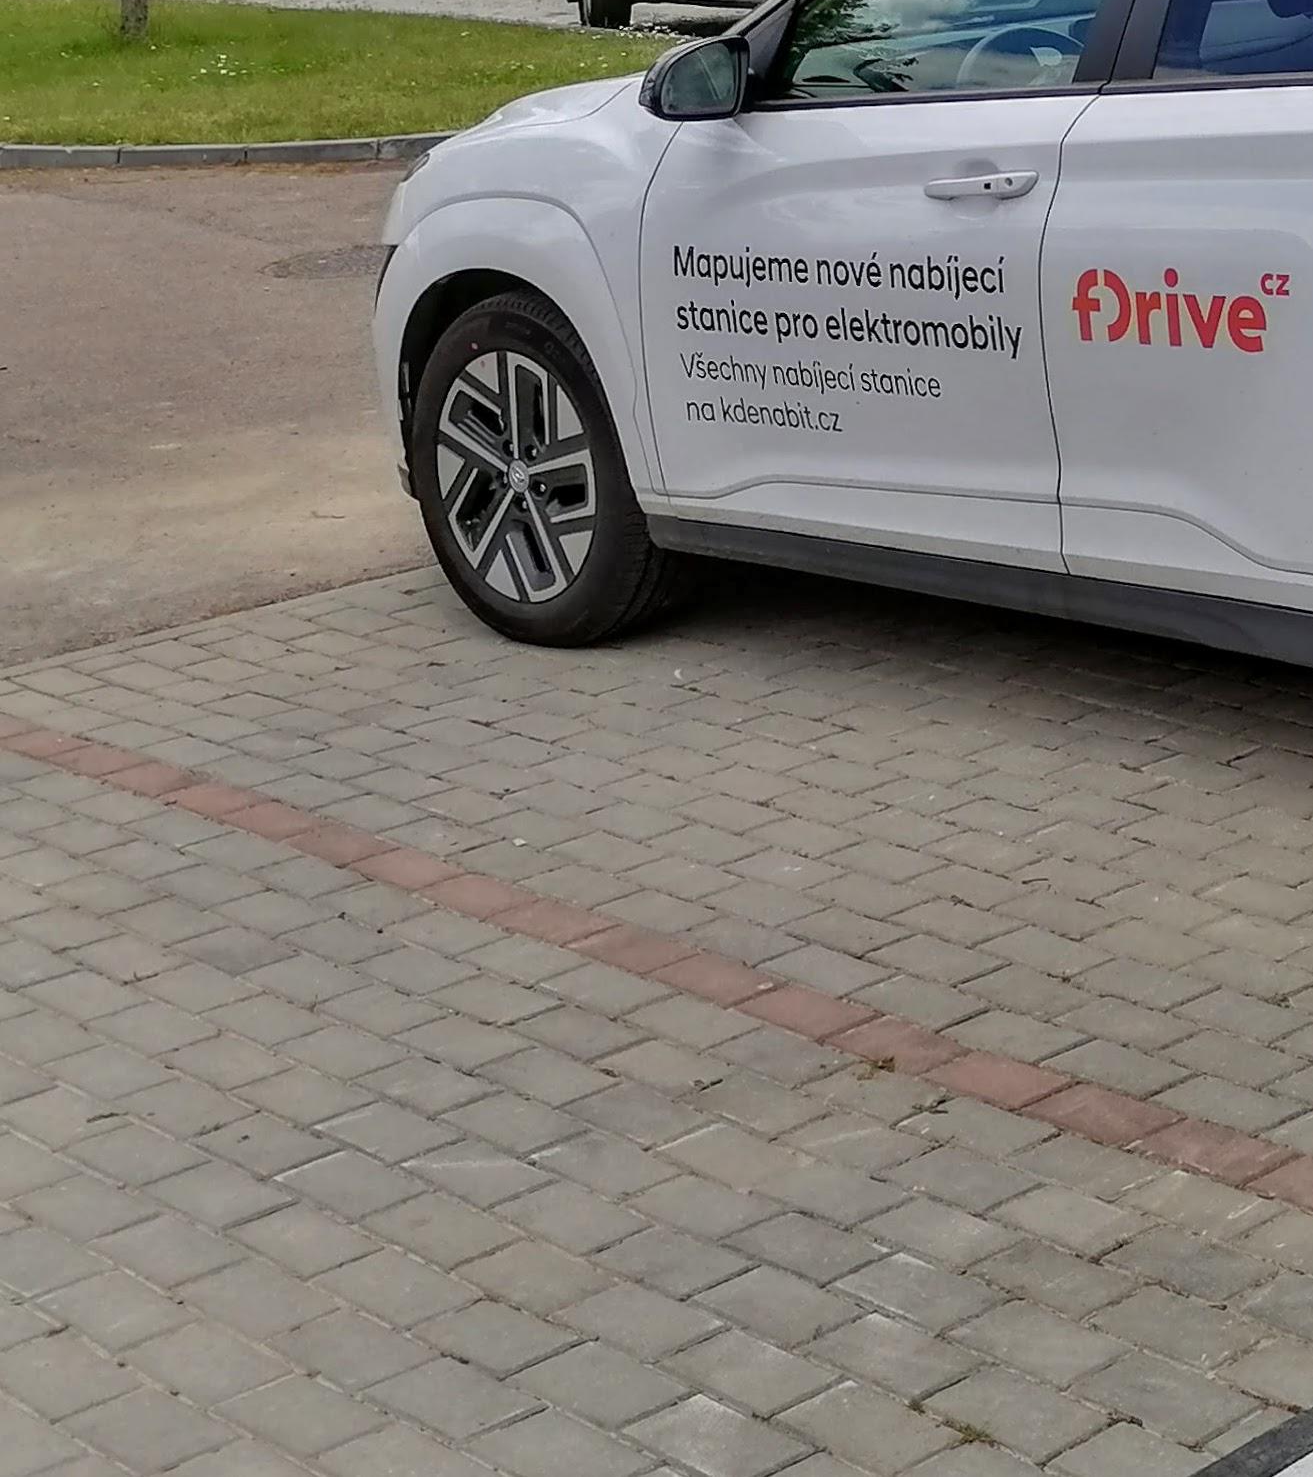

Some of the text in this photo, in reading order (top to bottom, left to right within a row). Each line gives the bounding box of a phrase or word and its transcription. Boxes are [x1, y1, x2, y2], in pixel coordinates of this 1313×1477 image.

[673, 245, 1005, 301] Mapujeme nové nabíjecí
[676, 299, 1023, 360] stanice pro elektromobily
[680, 351, 942, 398] Všechny nabíjecí stanice
[686, 396, 843, 432] na kdenabit.cz
